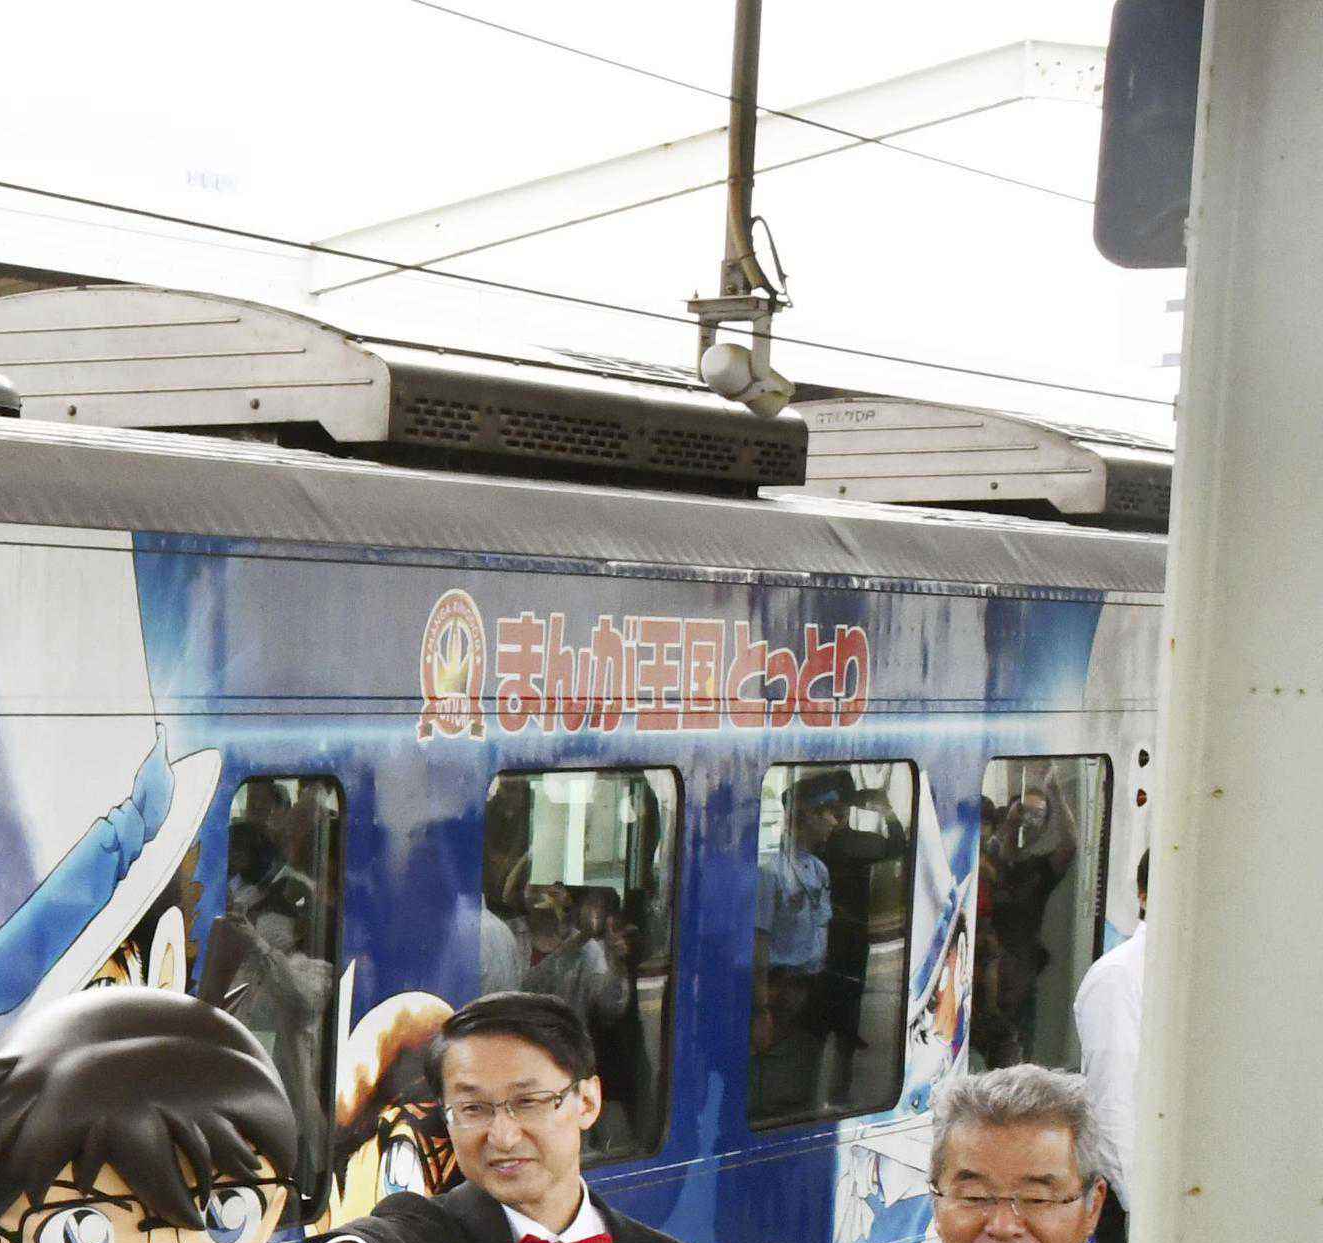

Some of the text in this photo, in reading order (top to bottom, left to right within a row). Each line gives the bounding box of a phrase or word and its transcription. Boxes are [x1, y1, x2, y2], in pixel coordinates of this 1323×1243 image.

[496, 612, 869, 733] まんが王国とっとり
